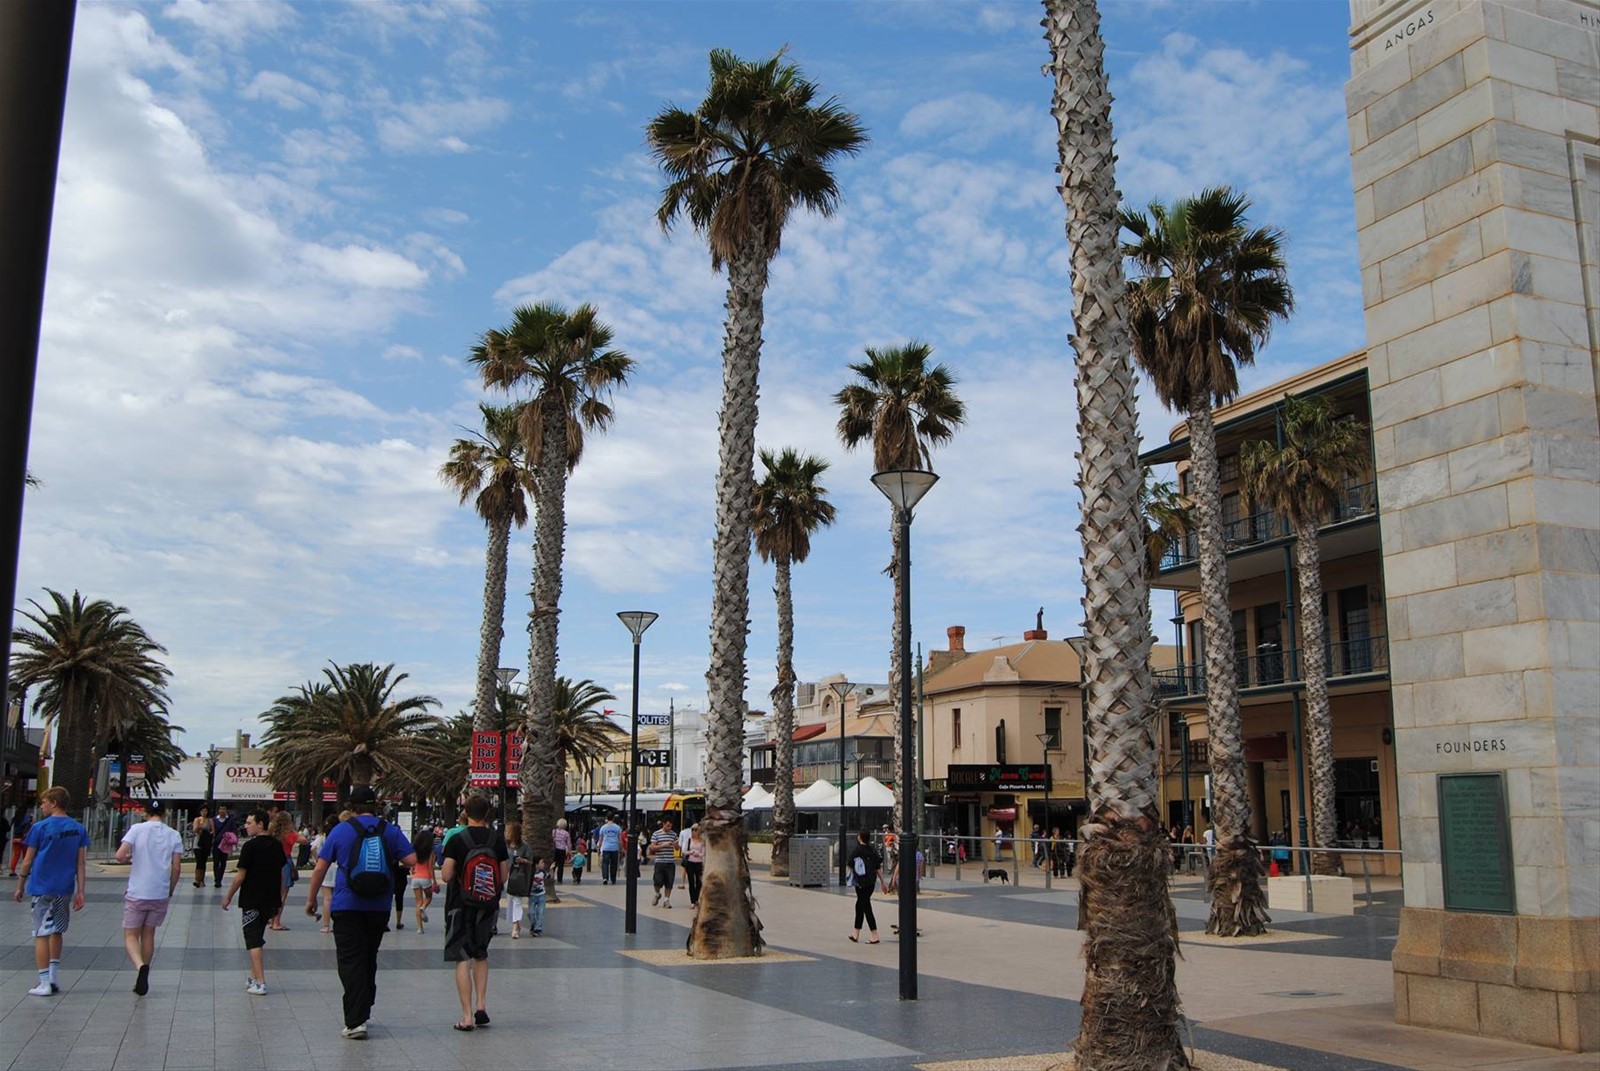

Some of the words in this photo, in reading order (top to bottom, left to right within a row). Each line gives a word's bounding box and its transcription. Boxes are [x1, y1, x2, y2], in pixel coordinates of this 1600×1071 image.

[1385, 10, 1434, 51] ANGAS
[477, 734, 497, 746] Bay
[1436, 739, 1506, 754] FOUNDERS
[477, 748, 496, 758] Bar
[476, 760, 496, 770] Dos
